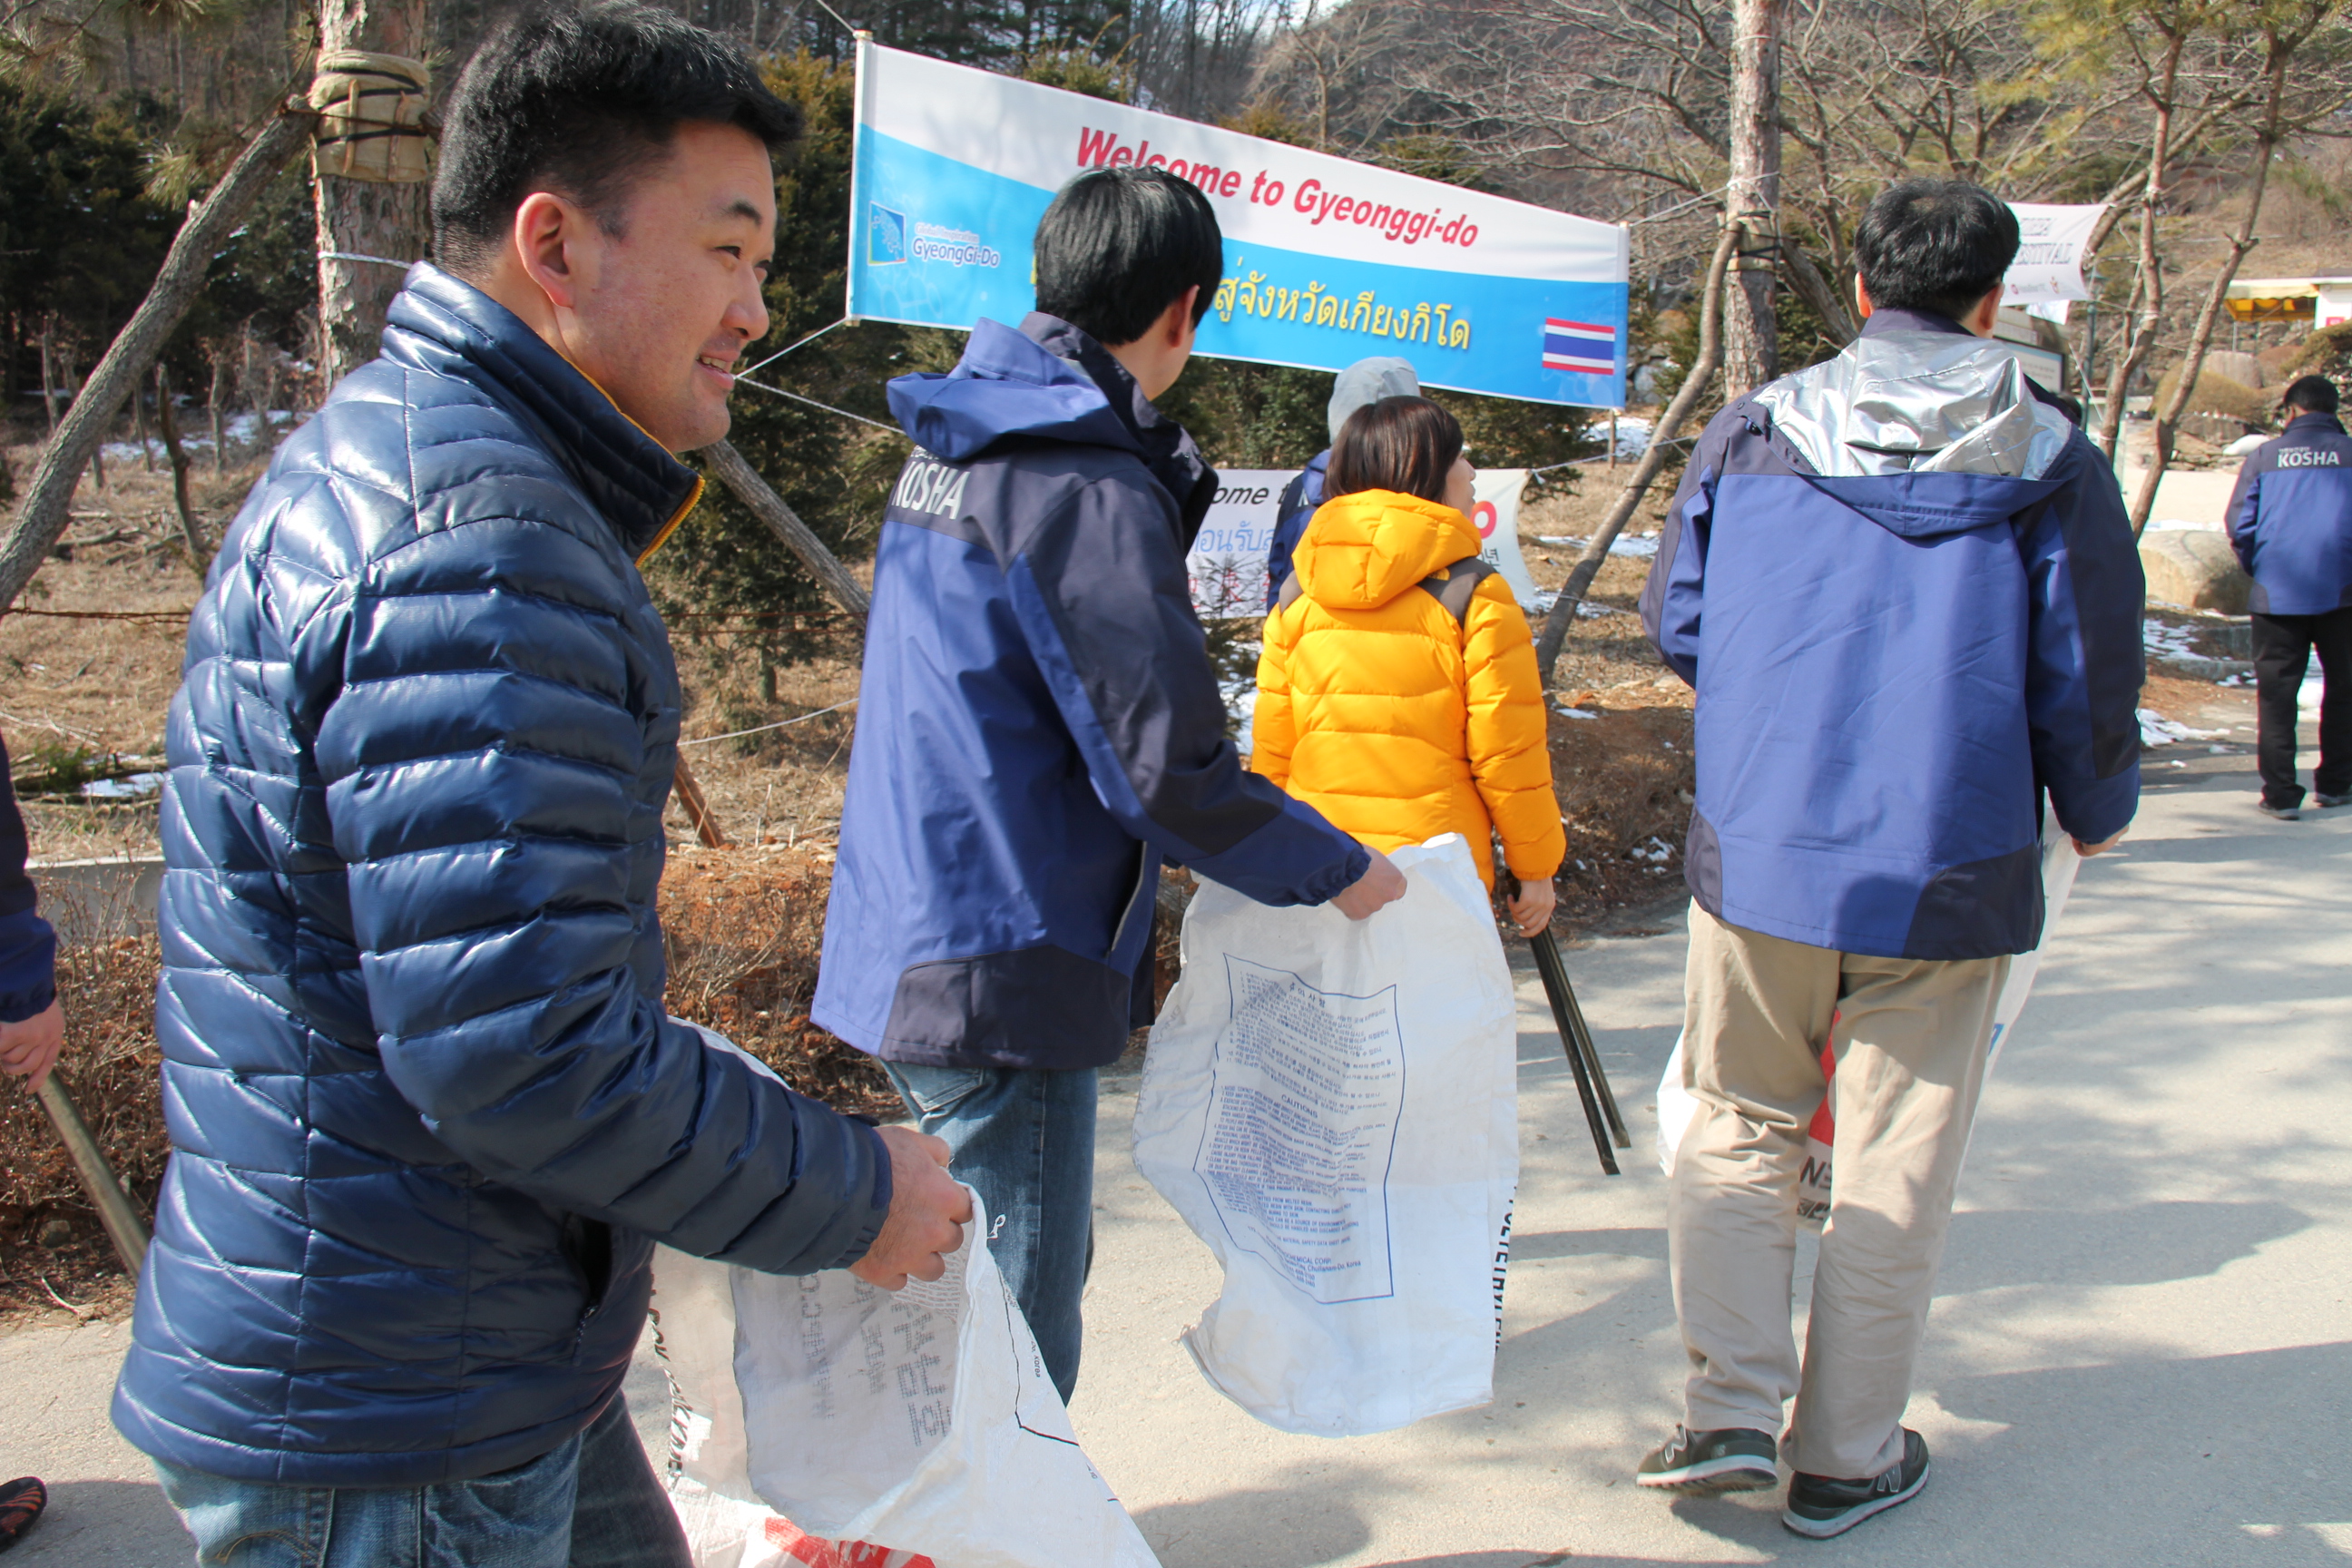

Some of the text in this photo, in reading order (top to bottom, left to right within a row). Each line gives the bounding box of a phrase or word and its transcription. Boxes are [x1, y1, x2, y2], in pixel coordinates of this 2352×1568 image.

[1250, 169, 1285, 207] to
[1293, 178, 1479, 248] Gyeonggi-do
[913, 237, 999, 267] GyeongGi-Do
[2277, 450, 2340, 468] KOSHA
[891, 460, 971, 520] KOSHA
[1210, 486, 1269, 505] ome
[1281, 1094, 1318, 1118] CAUTIONS
